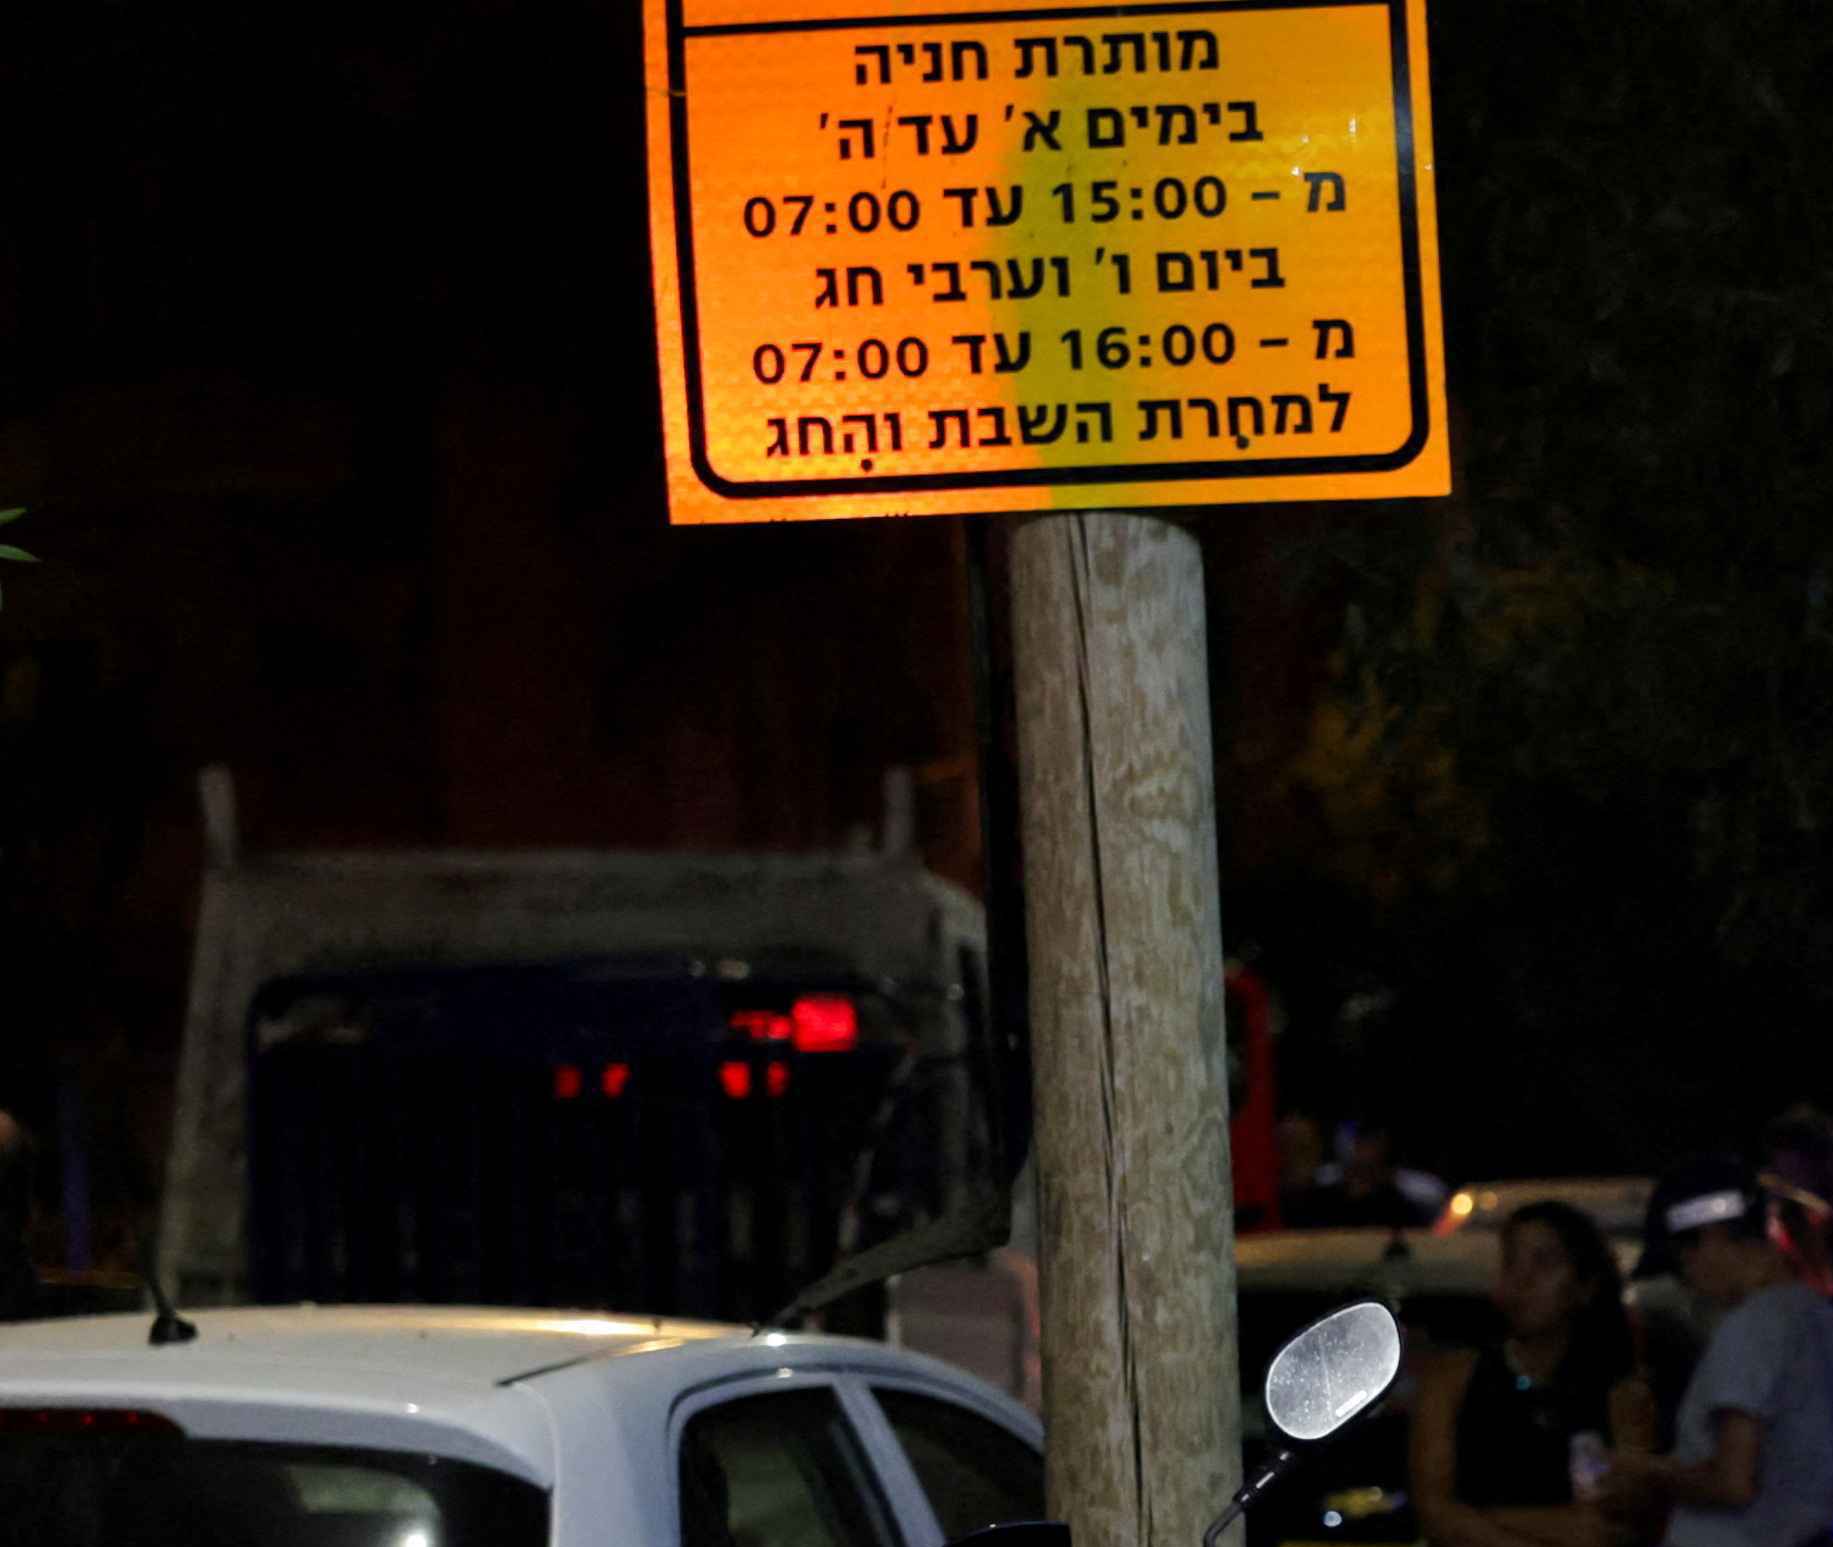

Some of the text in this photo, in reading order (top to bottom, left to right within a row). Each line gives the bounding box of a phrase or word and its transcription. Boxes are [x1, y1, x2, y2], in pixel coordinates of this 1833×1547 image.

[854, 28, 1221, 85] מותרת חניה
[897, 114, 979, 156] עד
[1085, 99, 1265, 151] בימים
[743, 189, 921, 238] 07:00
[942, 183, 1024, 229] עד
[1050, 175, 1228, 226] 15:00
[1303, 170, 1347, 213] מ
[814, 265, 884, 308] חג
[906, 254, 1072, 303] וערבי
[1154, 246, 1287, 294] ביום
[752, 336, 929, 385] 07:00
[952, 330, 1033, 376] עד
[1059, 322, 1236, 372] 16:00
[1311, 318, 1355, 361] מ
[766, 382, 1351, 458] למחרת השבת והחג
